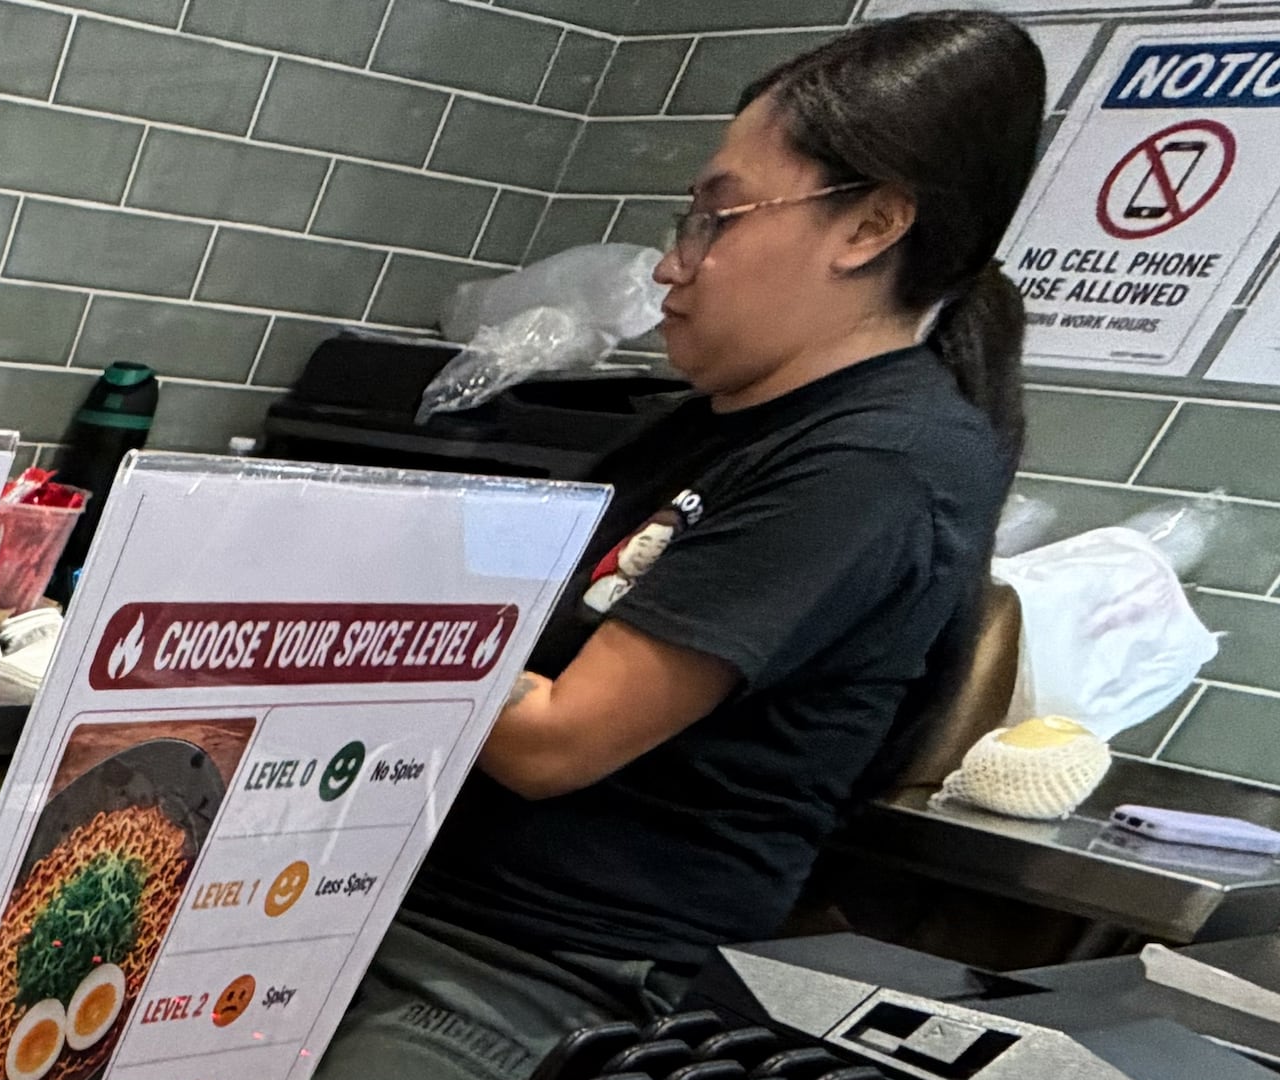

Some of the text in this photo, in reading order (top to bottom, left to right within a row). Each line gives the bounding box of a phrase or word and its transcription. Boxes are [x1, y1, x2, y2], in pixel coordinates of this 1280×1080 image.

[1118, 51, 1280, 100] NOTIC
[1018, 247, 1222, 279] NO CELL PHONE
[1017, 277, 1190, 309] USE ALLOWED
[1059, 312, 1107, 331] WORK
[1107, 314, 1161, 334] HOURS
[153, 618, 479, 672] CHOOSE YOUR SPICE LEVEL
[243, 757, 426, 793] LEVEL 0 No Spice
[191, 872, 378, 912] LEVEL 1 Less Spicy
[140, 985, 297, 1026] LEVEL 2 Spicy
